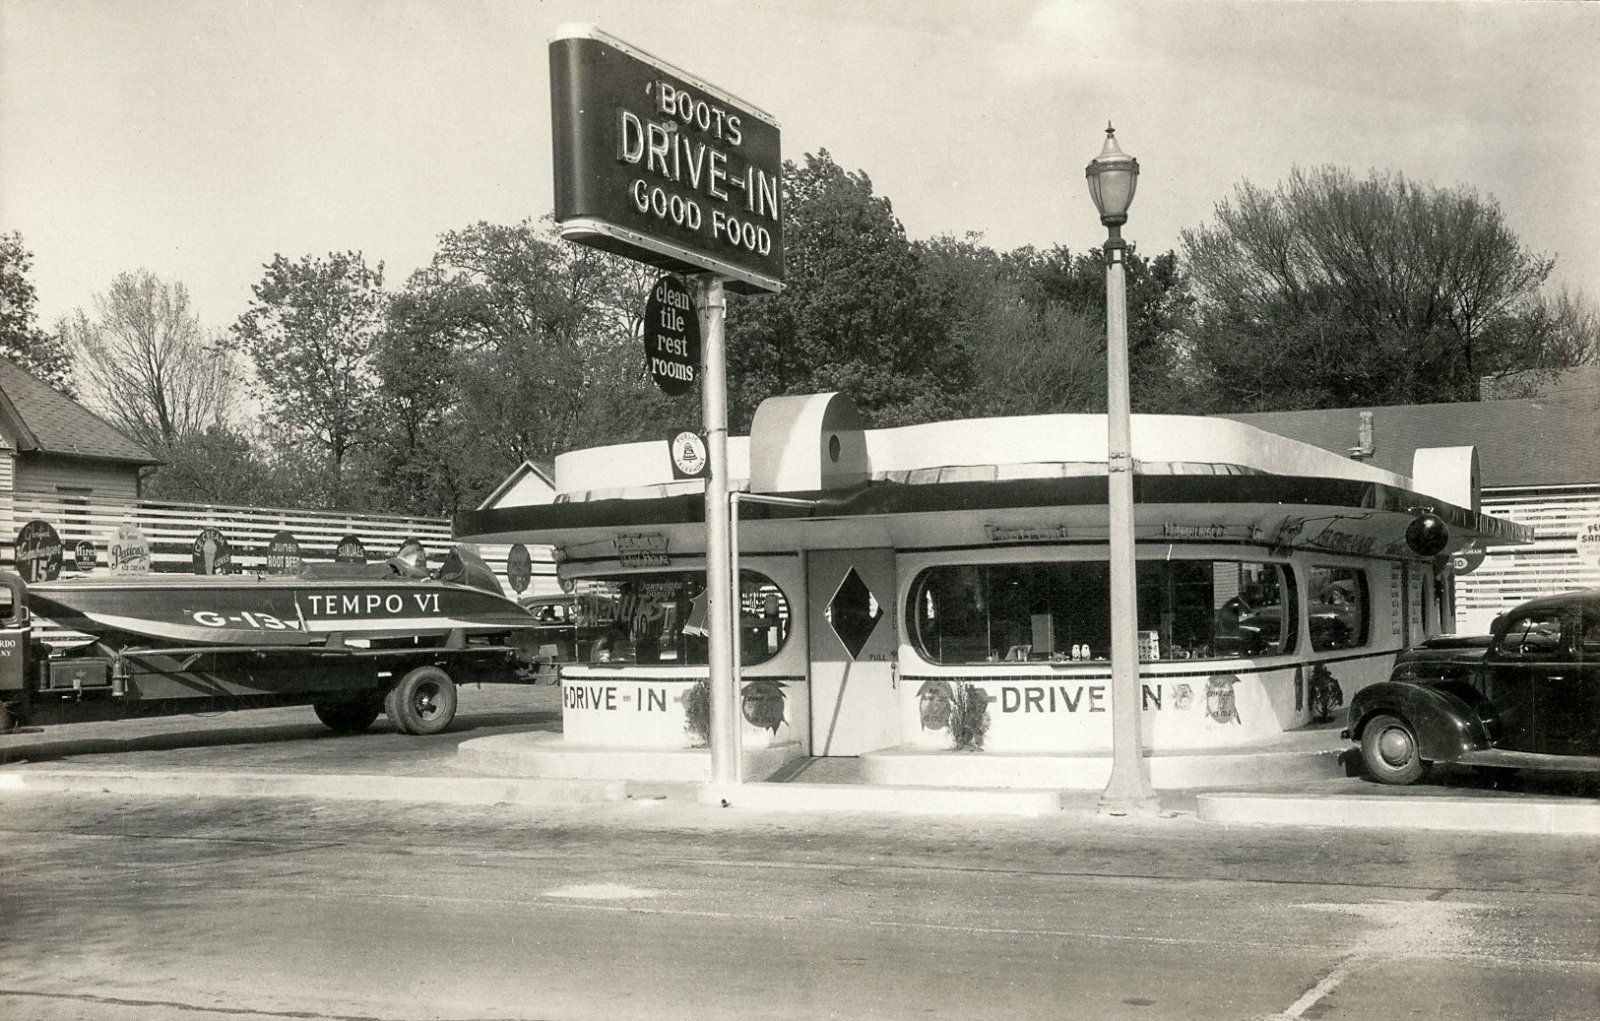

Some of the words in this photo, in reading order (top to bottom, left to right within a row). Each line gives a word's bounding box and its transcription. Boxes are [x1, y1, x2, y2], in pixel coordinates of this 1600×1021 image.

[617, 108, 779, 221] DRIVE-IN
[630, 178, 702, 232] GOOD
[711, 209, 772, 257] FOOD
[656, 281, 691, 312] clean
[659, 307, 685, 333] tile
[657, 333, 688, 358] rest
[651, 355, 694, 382] rooms
[268, 555, 284, 567] ROOT
[308, 594, 403, 615] TEMPO
[413, 593, 441, 613] VI
[869, 653, 887, 662] PULL
